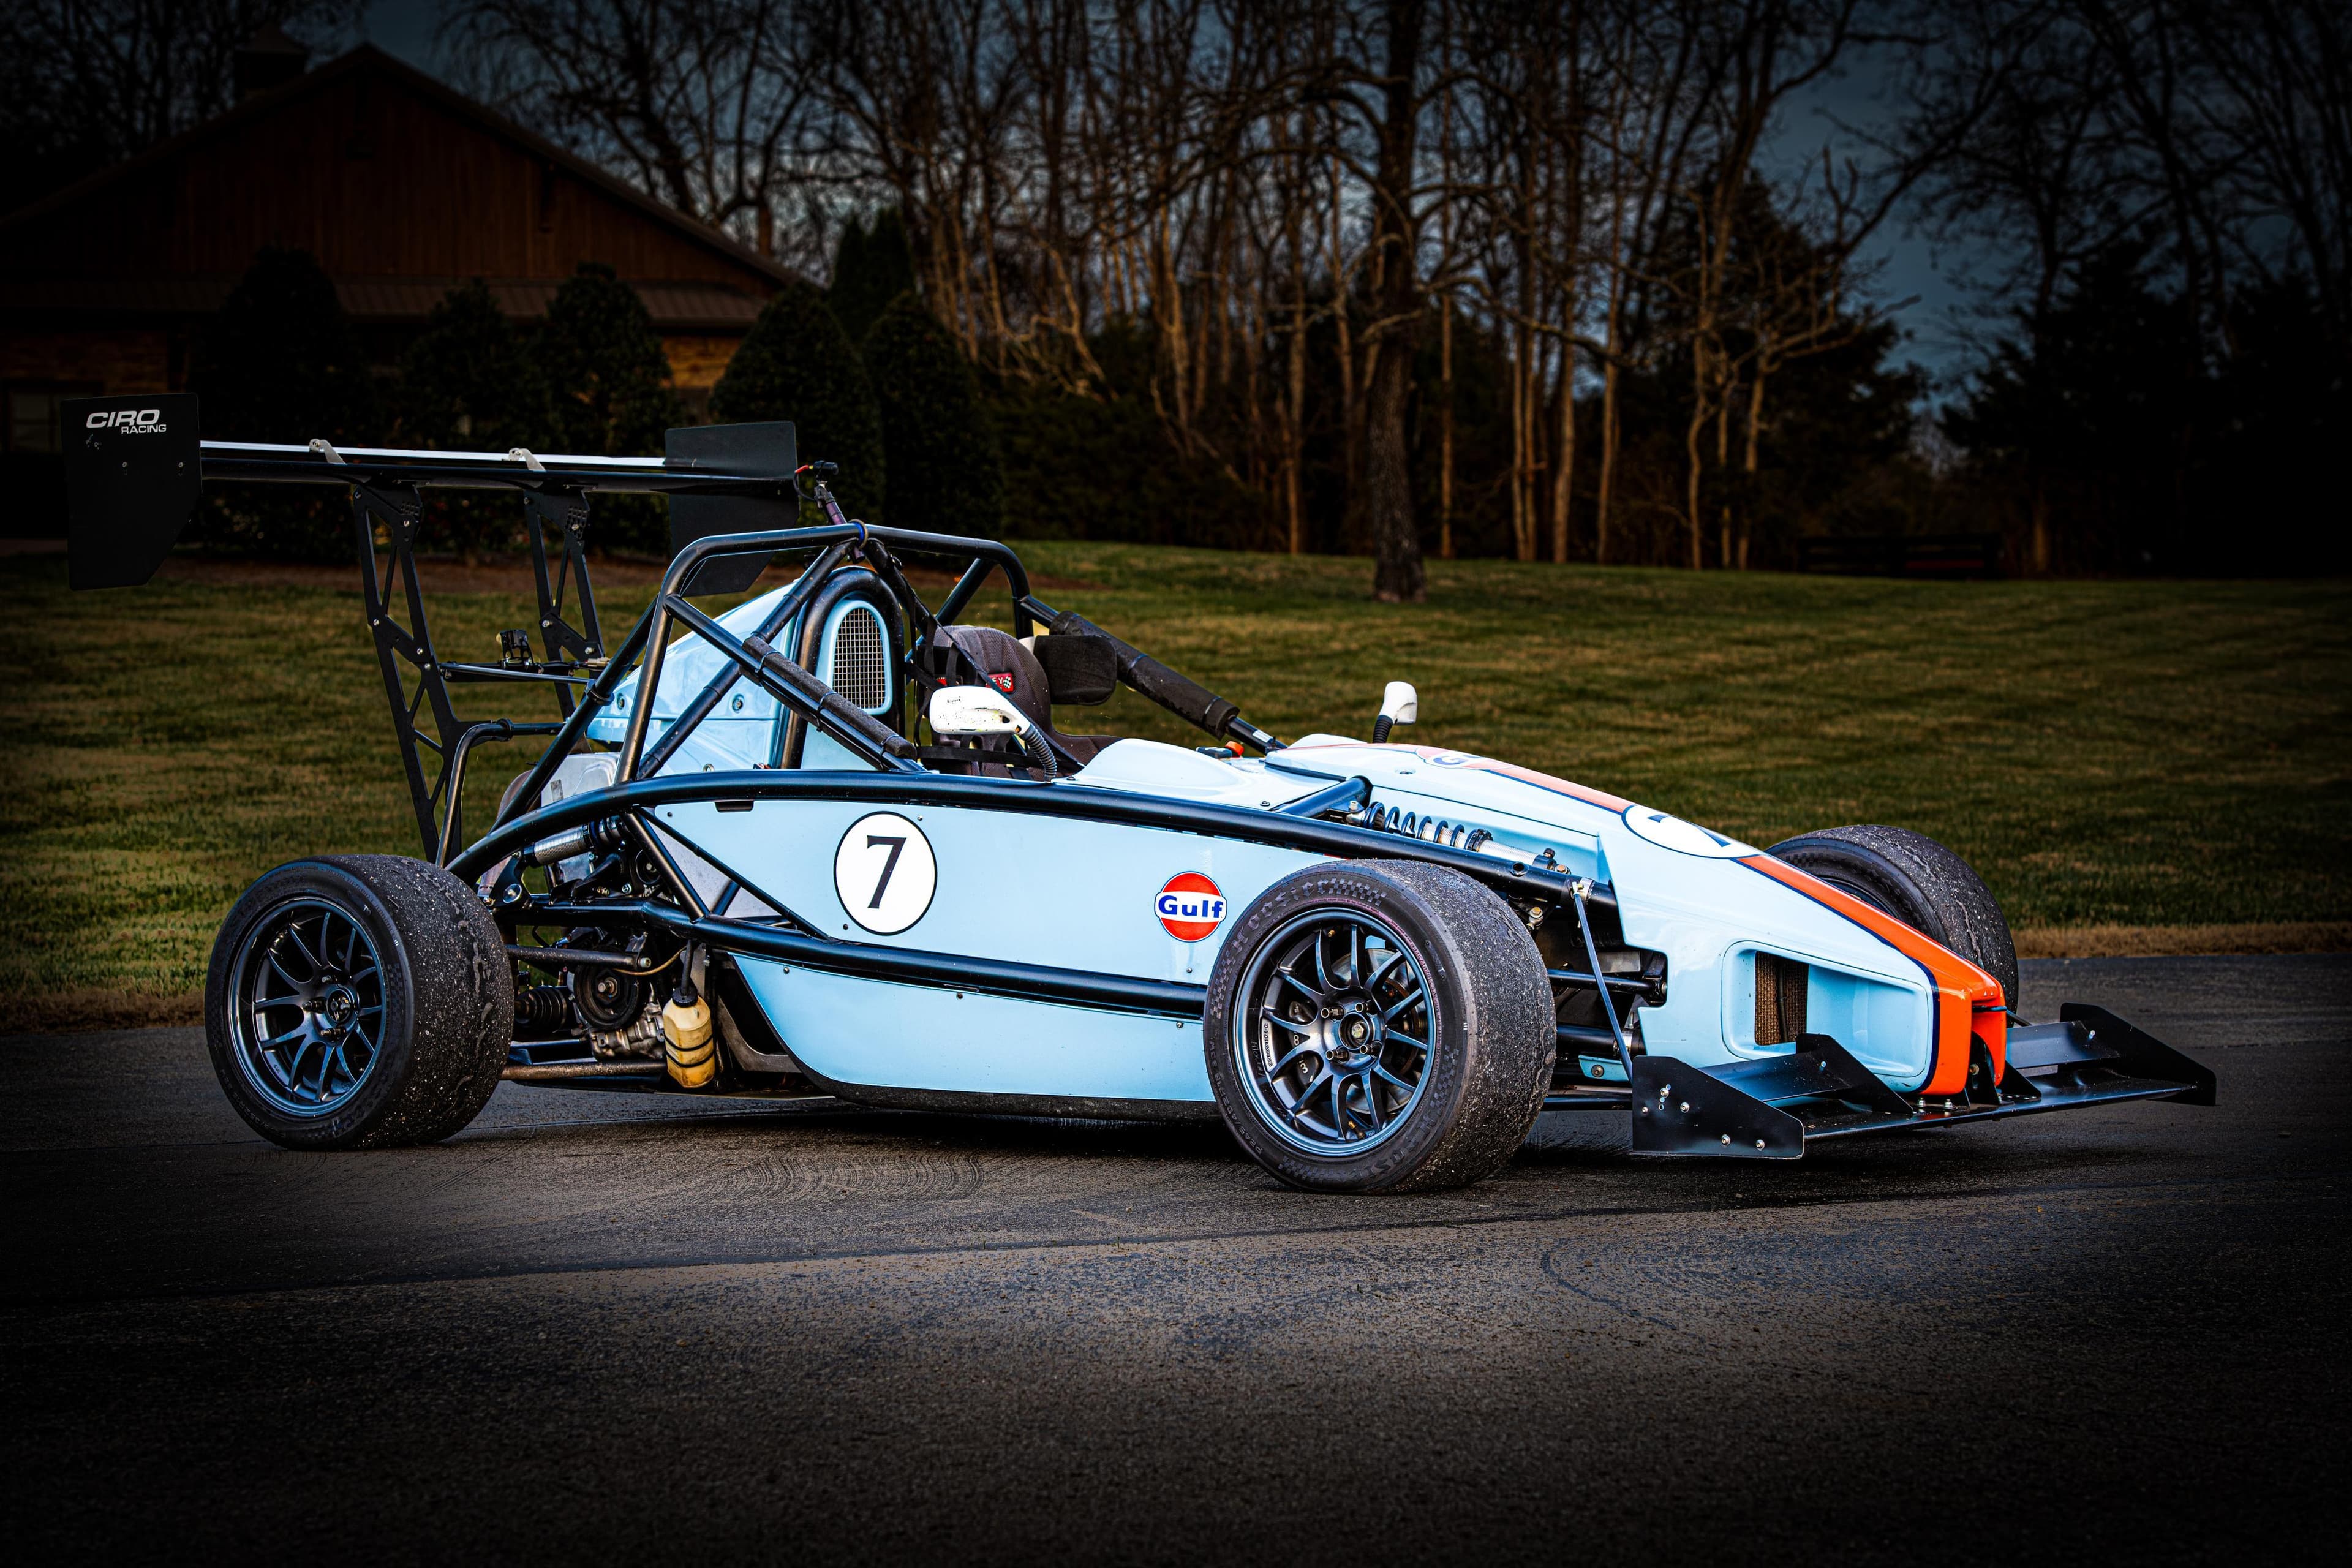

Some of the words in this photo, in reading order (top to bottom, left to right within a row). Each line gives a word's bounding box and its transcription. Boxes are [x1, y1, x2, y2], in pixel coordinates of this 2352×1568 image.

[86, 409, 160, 428] CIRO
[121, 424, 167, 435] RACING
[867, 835, 907, 909] 7
[1158, 895, 1224, 918] Gulf
[1231, 878, 1329, 953] Hoosier
